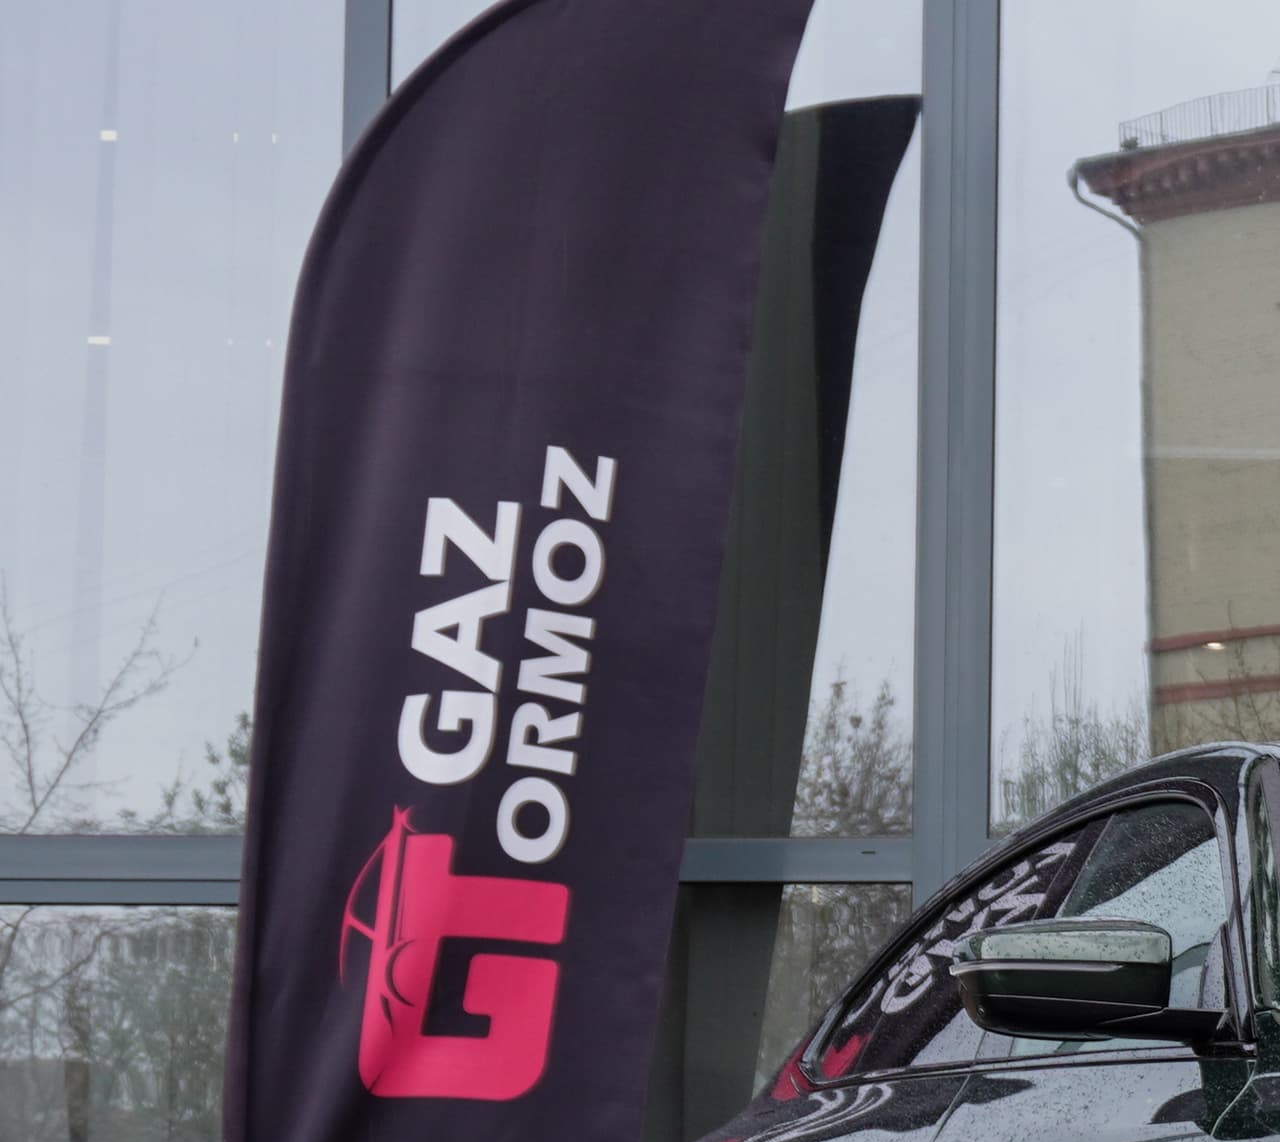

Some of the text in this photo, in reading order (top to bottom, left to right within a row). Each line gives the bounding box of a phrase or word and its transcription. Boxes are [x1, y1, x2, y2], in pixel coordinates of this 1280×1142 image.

[398, 497, 521, 785] GAZ
[497, 445, 617, 863] ORMOZ
[358, 833, 570, 1100] GT
